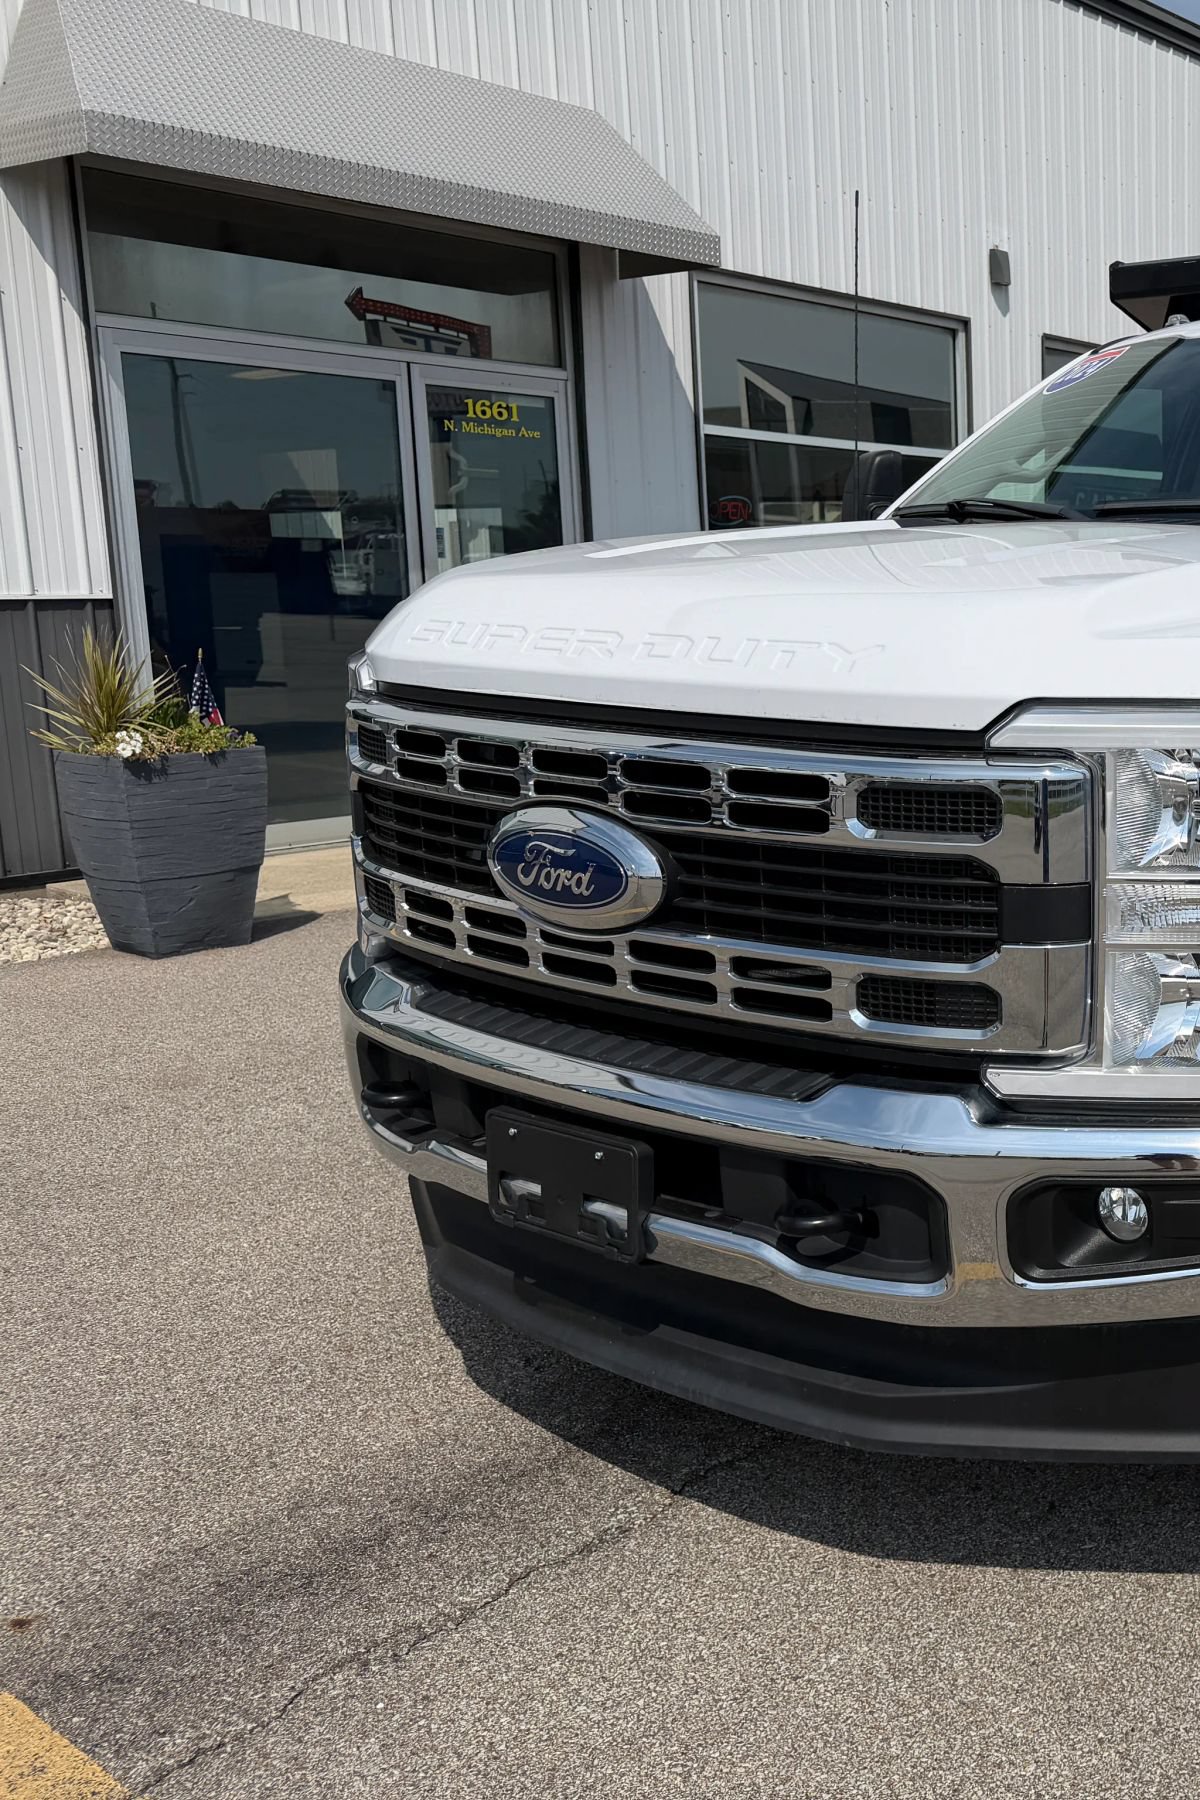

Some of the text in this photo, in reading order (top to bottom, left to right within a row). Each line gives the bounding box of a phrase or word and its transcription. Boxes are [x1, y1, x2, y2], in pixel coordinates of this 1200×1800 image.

[443, 419, 541, 438] N. Michigan Ave
[464, 399, 520, 422] 1661
[407, 619, 886, 673] SUPER DUTY
[517, 841, 597, 897] Ford
